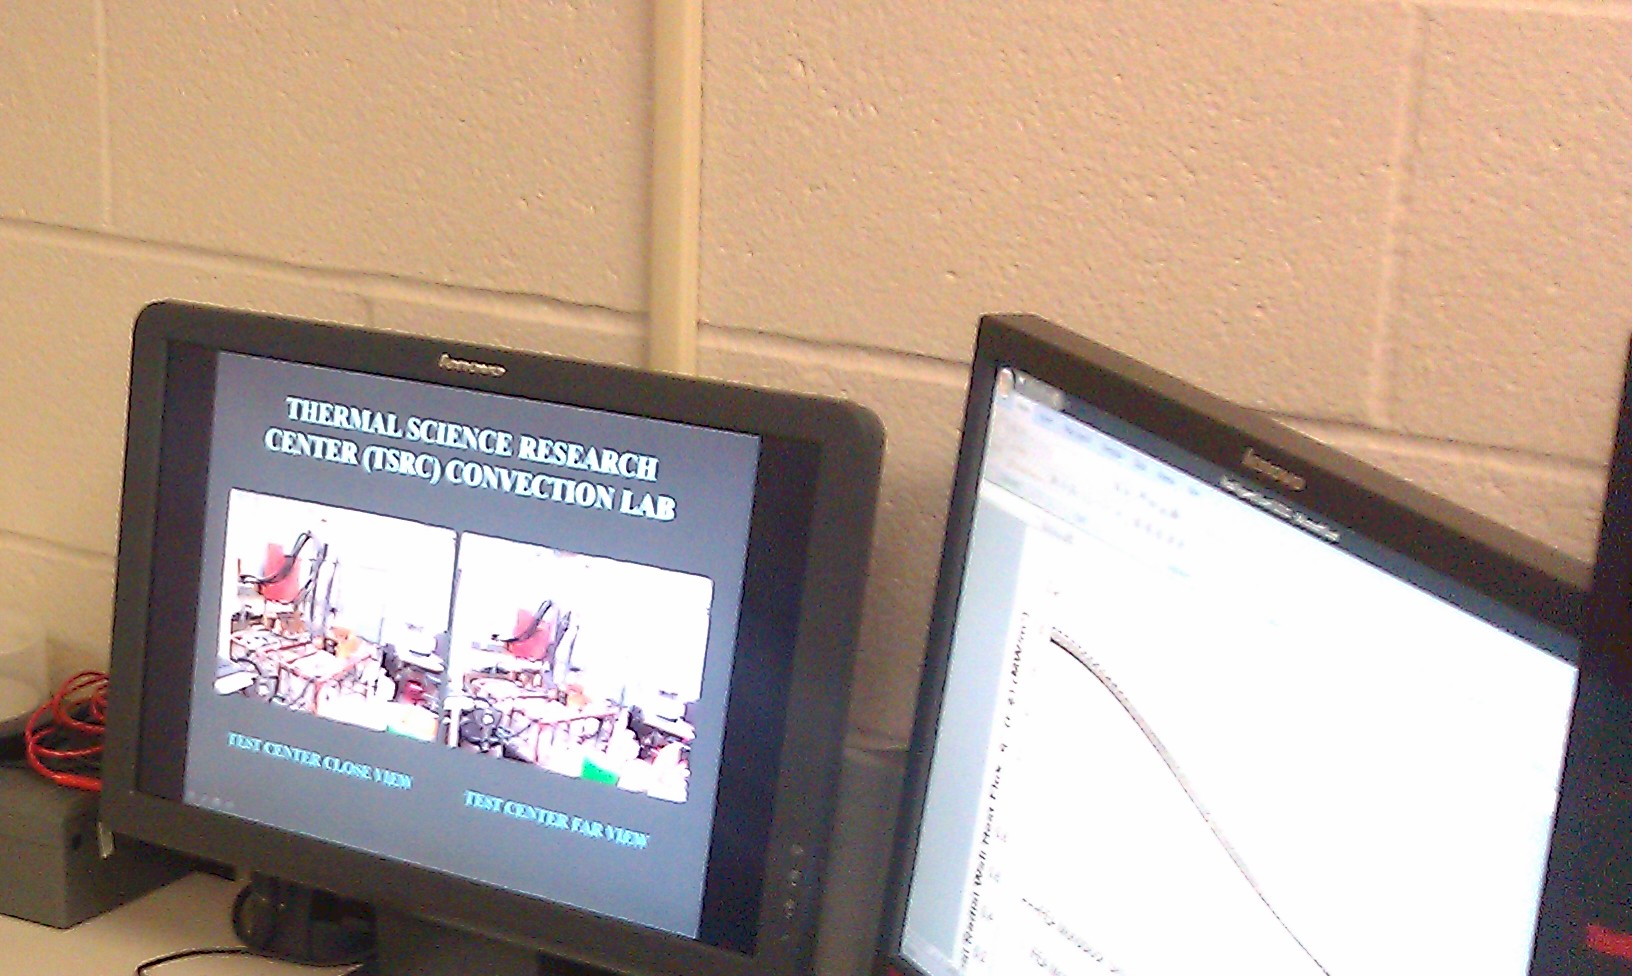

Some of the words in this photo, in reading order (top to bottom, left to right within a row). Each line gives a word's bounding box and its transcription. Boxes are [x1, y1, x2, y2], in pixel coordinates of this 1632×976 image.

[285, 396, 403, 438] THERMAL
[406, 416, 513, 457] SCIENCE
[518, 435, 659, 481] RESEARCH
[265, 428, 358, 465] CENTER
[362, 445, 443, 485] (TSRC)
[445, 458, 615, 511] CONVECTION
[620, 488, 677, 522] LAB
[228, 732, 261, 752] TEST
[263, 740, 322, 768] CENTER
[322, 756, 372, 780] CLOSE
[373, 767, 414, 790] VIEW
[464, 790, 503, 813] TEST
[503, 800, 571, 830] CENTER
[571, 816, 606, 839] FAR
[605, 824, 650, 850] VIEW
